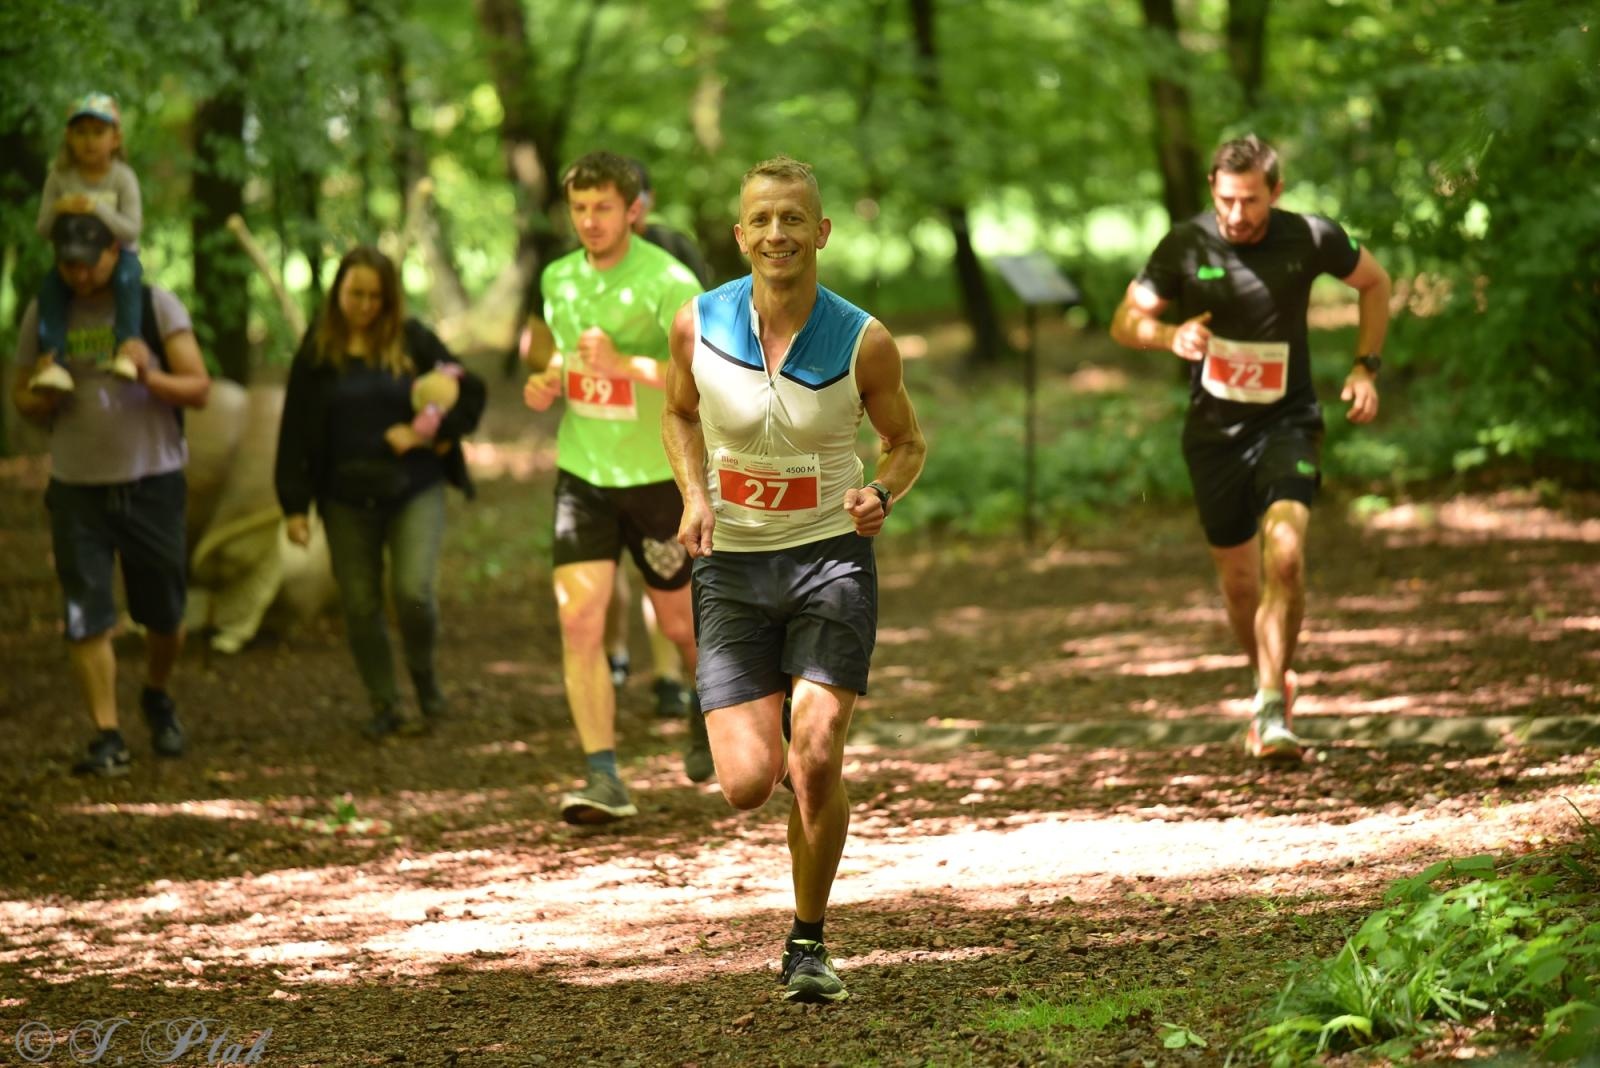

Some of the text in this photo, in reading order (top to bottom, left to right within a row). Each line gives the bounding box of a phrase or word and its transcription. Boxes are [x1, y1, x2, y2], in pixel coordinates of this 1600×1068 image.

[1227, 363, 1264, 388] 72
[581, 376, 613, 404] 99
[785, 466, 806, 474] 4500
[807, 465, 816, 473] M
[744, 478, 789, 508] 27
